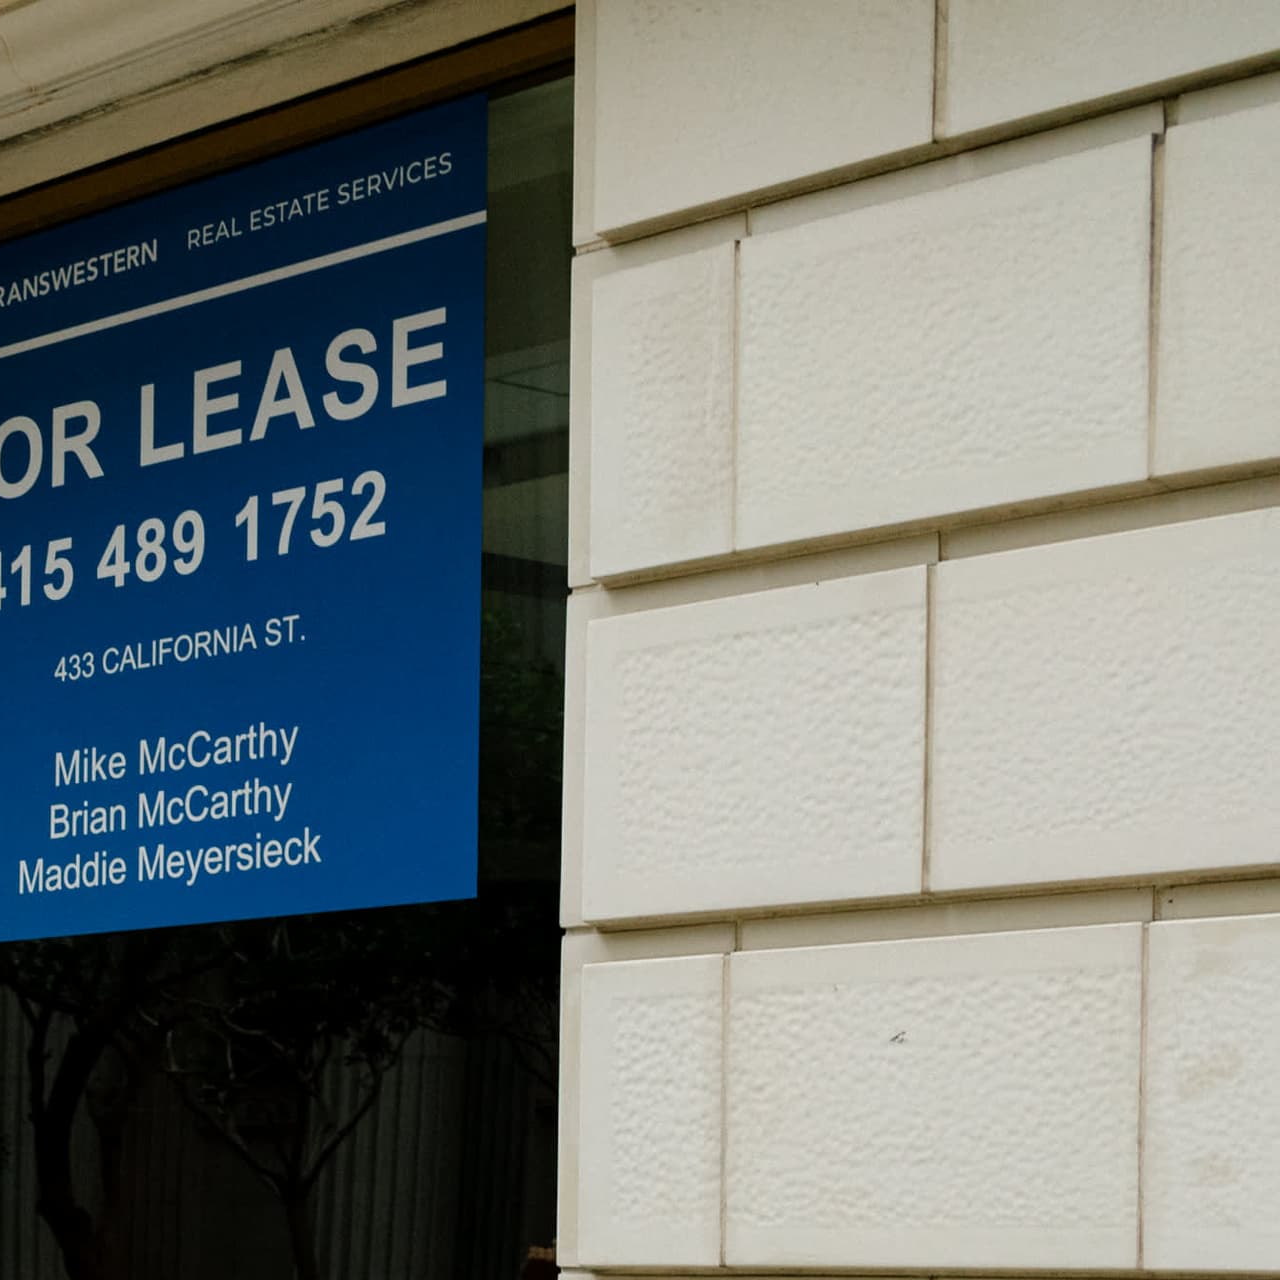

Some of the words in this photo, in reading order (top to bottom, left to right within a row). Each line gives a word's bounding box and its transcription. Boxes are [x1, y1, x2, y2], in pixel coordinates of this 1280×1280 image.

[188, 218, 242, 249] REAL
[251, 189, 330, 230] ESTATE
[338, 153, 452, 204] SERVICES
[140, 307, 447, 466] LEASE
[97, 510, 205, 588] 489
[235, 470, 386, 562] 1752
[54, 652, 95, 682] 433
[102, 624, 257, 674] CALIFORNIA
[265, 615, 306, 647] ST.
[55, 747, 126, 786] Mike
[139, 722, 298, 775] McCarthy
[49, 802, 126, 839] Brian
[138, 779, 293, 828] McCarthy
[18, 855, 127, 894] Maddie
[138, 827, 322, 886] Meyersieck
